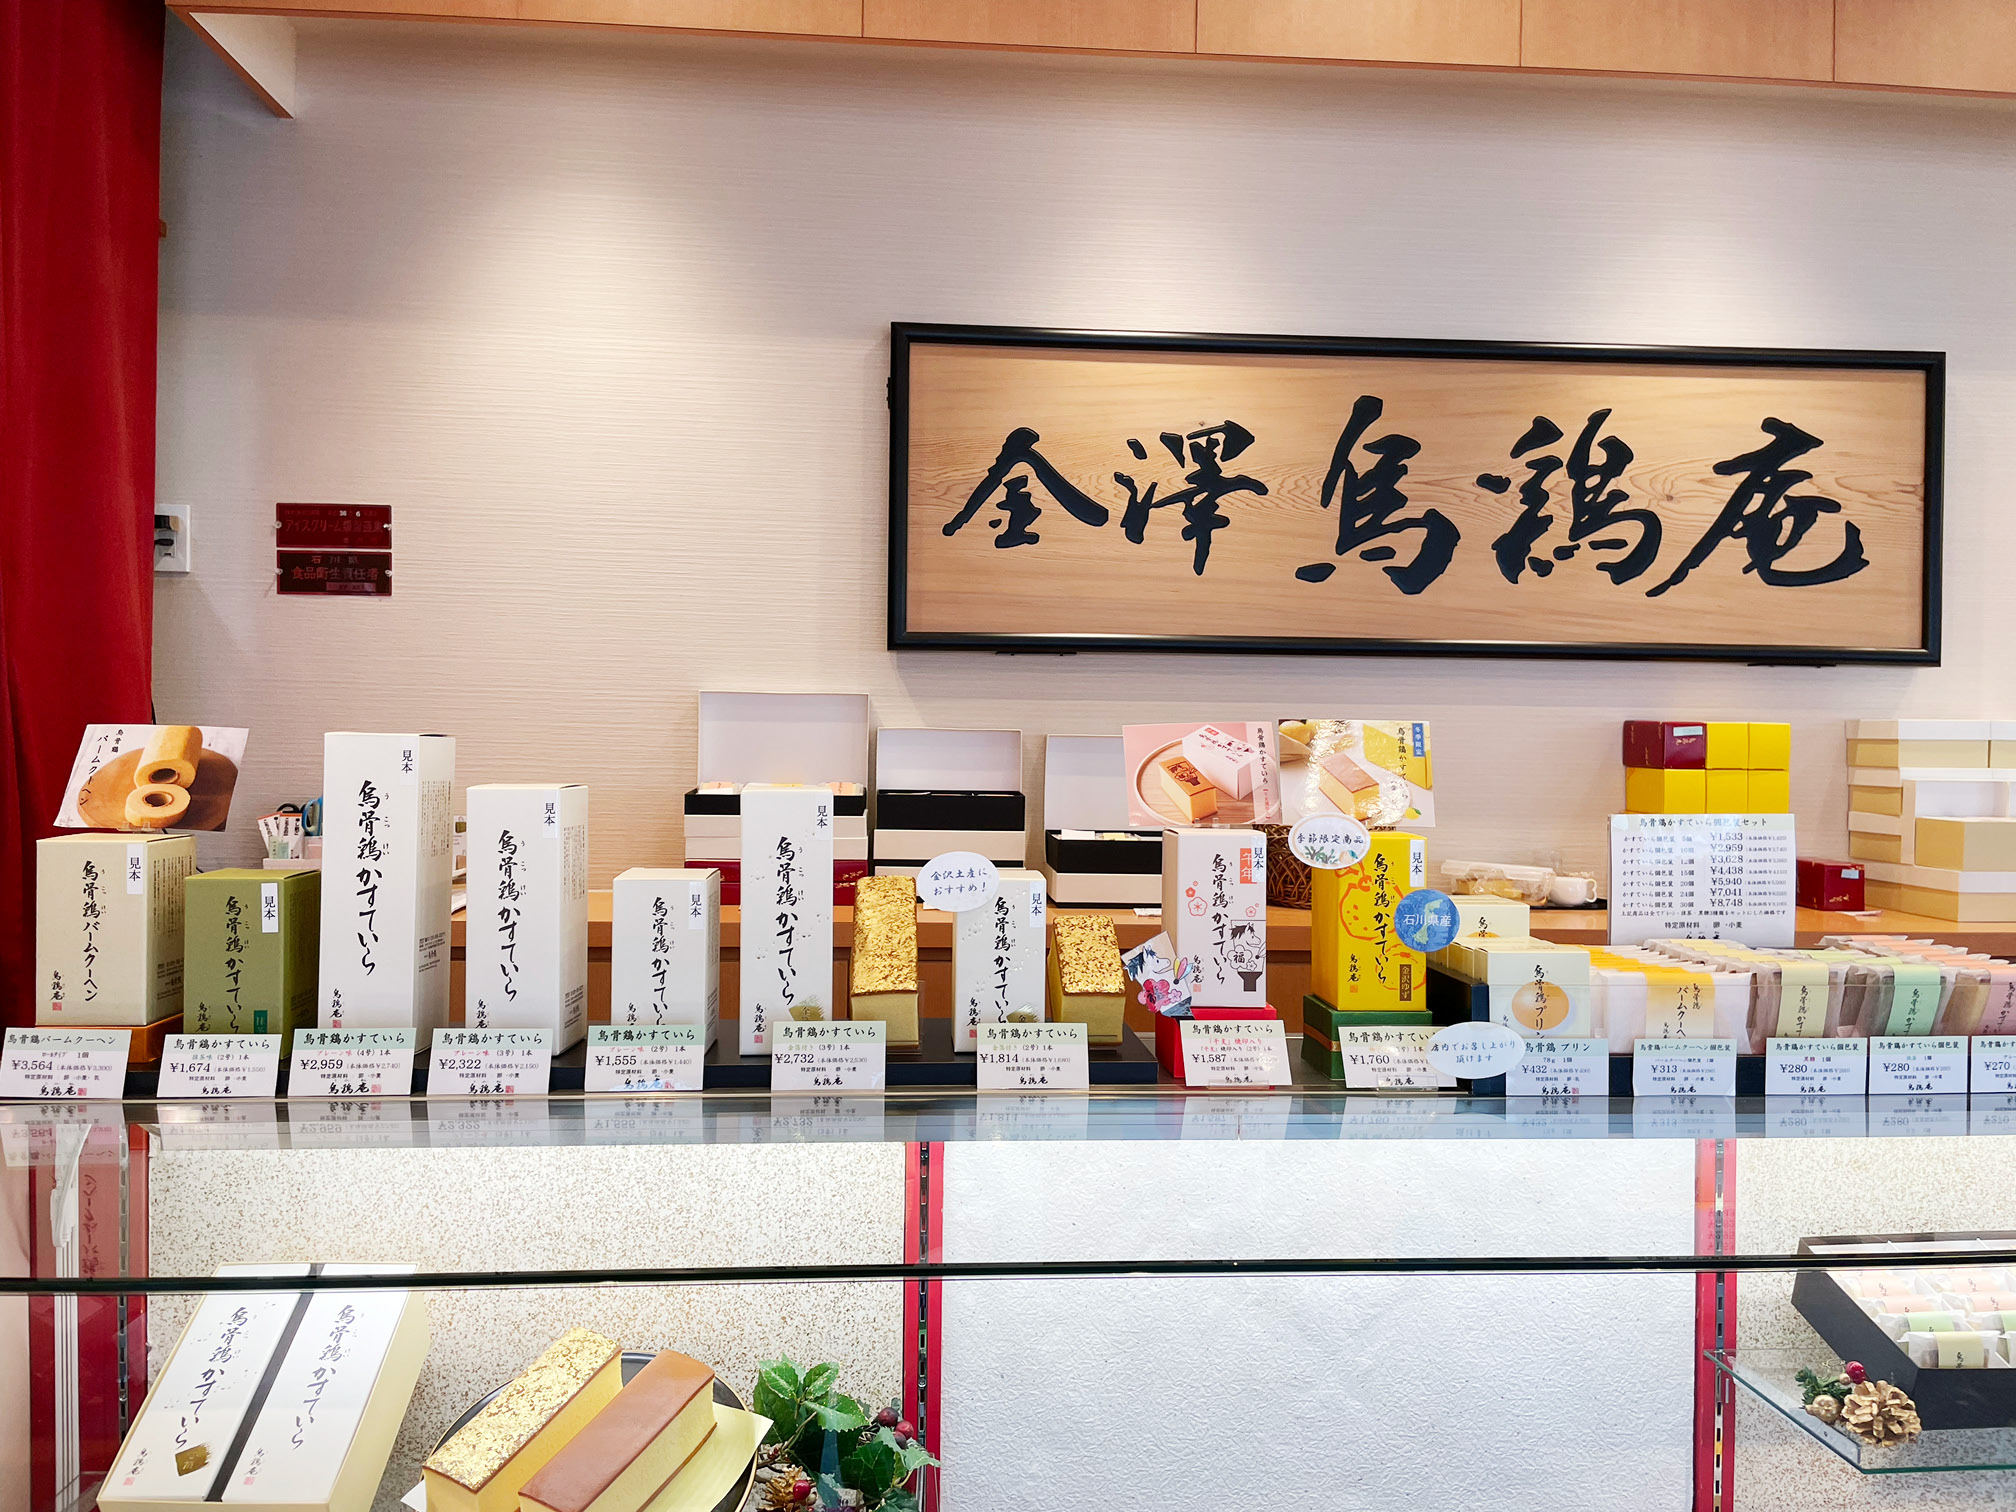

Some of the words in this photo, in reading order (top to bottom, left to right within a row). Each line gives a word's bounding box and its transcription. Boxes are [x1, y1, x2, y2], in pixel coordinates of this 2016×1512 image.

[401, 749, 413, 775] 見本
[79, 735, 109, 806] バームクーヘン
[543, 802, 556, 827] 見本
[817, 805, 828, 829] 見本
[1296, 831, 1364, 845] 季節限定商品
[1709, 832, 1743, 842] ¥1,533
[1710, 844, 1743, 852] ¥2,959
[1254, 847, 1264, 869] 見本
[1411, 852, 1423, 876] 見本
[1710, 855, 1744, 864] ¥3,628
[128, 856, 141, 881] 見本
[930, 867, 988, 882] 金沢土産に
[1710, 866, 1744, 875] ¥4,438
[1711, 877, 1743, 886] ¥5,940
[933, 882, 987, 896] おすすめ!
[1709, 888, 1743, 897] ¥7,041
[263, 895, 276, 921] 見本
[690, 894, 702, 918] 見本
[1031, 893, 1042, 916] 見本
[1709, 898, 1743, 907] ¥8,748
[1403, 914, 1452, 927] 石川県産
[1233, 952, 1246, 964] 福
[1401, 966, 1410, 999] 金沢ゆず
[1676, 986, 1690, 1039] バームクーヘ
[783, 1026, 877, 1039] 烏骨鶏かすていら
[986, 1028, 1078, 1040] 烏骨鶏かすていら
[1192, 1023, 1274, 1035] 烏骨鶏かすていら
[7, 1033, 117, 1046] 烏骨鶏バームクーヘン
[303, 1033, 406, 1046] 烏骨鶏かすていら
[442, 1033, 543, 1046] 烏骨鶏かすていら
[597, 1029, 696, 1042] 烏骨鶏かすていら
[1348, 1031, 1436, 1043] 烏骨鶏かすてい
[174, 1038, 271, 1050] 烏骨鶏かすていら
[650, 1045, 669, 1053] (2号)
[839, 1044, 851, 1052] 1本
[1430, 1042, 1517, 1052] 店内でお召し上がり
[1561, 1042, 1591, 1052] プリン
[77, 1051, 90, 1059] 1個
[216, 1053, 235, 1061] (2号)
[356, 1049, 375, 1057] (4号)
[496, 1049, 515, 1057] (3号)
[774, 1053, 815, 1065] ¥2,732
[979, 1053, 1019, 1064] ¥1,814
[1191, 1053, 1227, 1064] ¥1,587
[1456, 1054, 1493, 1064] 頂けます
[11, 1059, 54, 1071] ¥3,564
[300, 1059, 343, 1070] ¥2,959
[439, 1058, 482, 1070] ¥2,322
[595, 1055, 637, 1067] ¥1,555
[1349, 1054, 1390, 1065] ¥1,760
[170, 1062, 211, 1074] ¥1,674
[1521, 1065, 1548, 1074] ¥432
[1650, 1064, 1678, 1073] ¥313
[1780, 1064, 1808, 1073] ¥280
[1883, 1062, 1910, 1072] ¥280
[1984, 1061, 2011, 1071] ¥270
